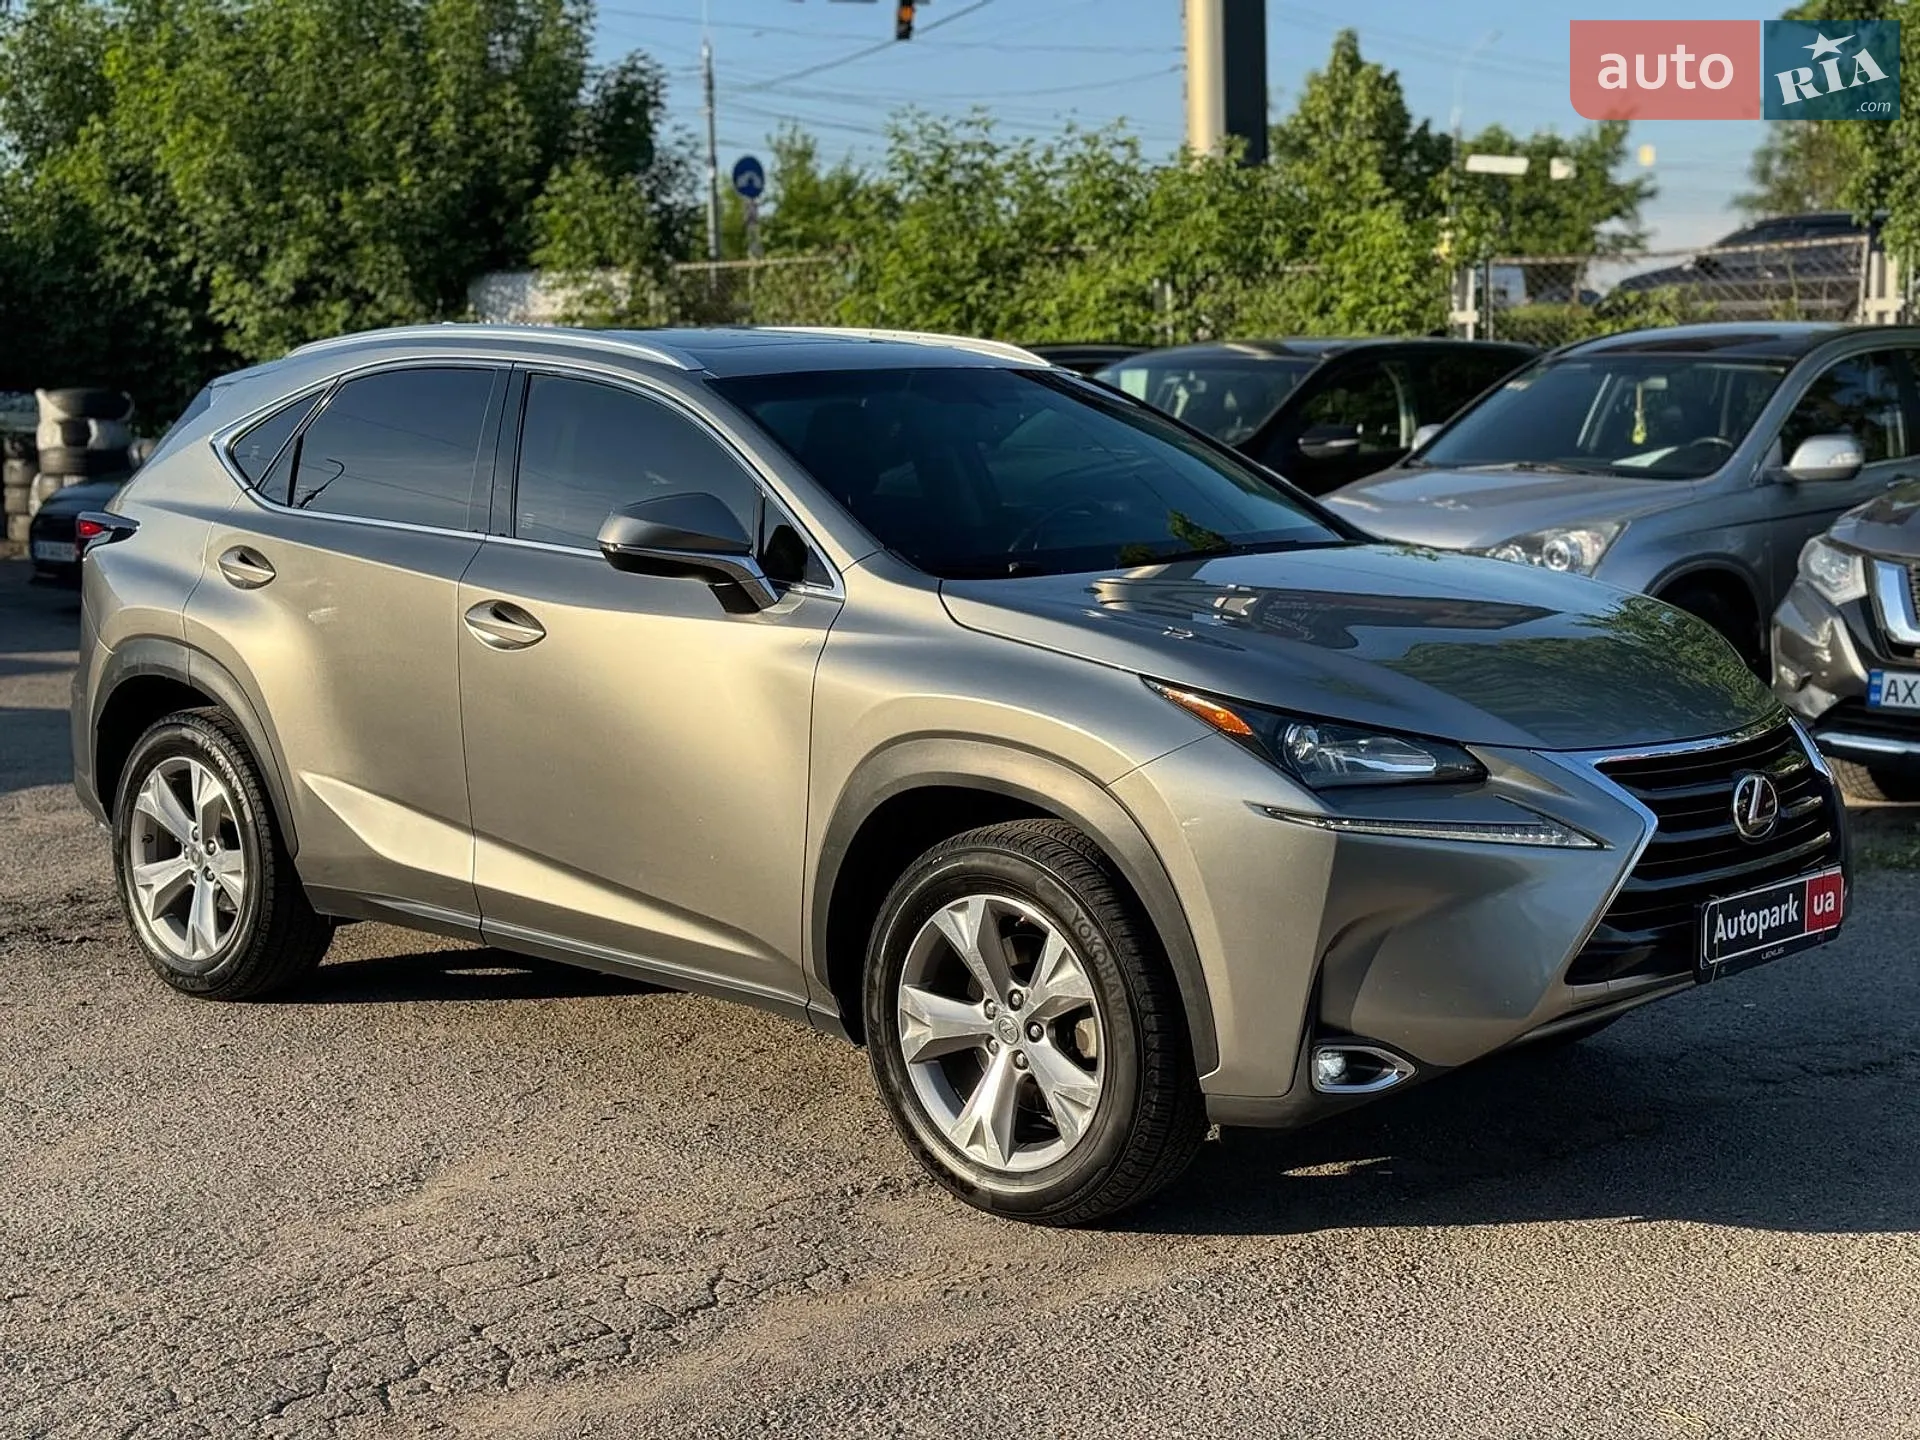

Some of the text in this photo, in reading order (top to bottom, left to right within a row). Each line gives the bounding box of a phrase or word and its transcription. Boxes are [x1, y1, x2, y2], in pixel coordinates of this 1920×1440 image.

[1885, 679, 1919, 704] AX
[1713, 891, 1835, 944] Autopark ua
